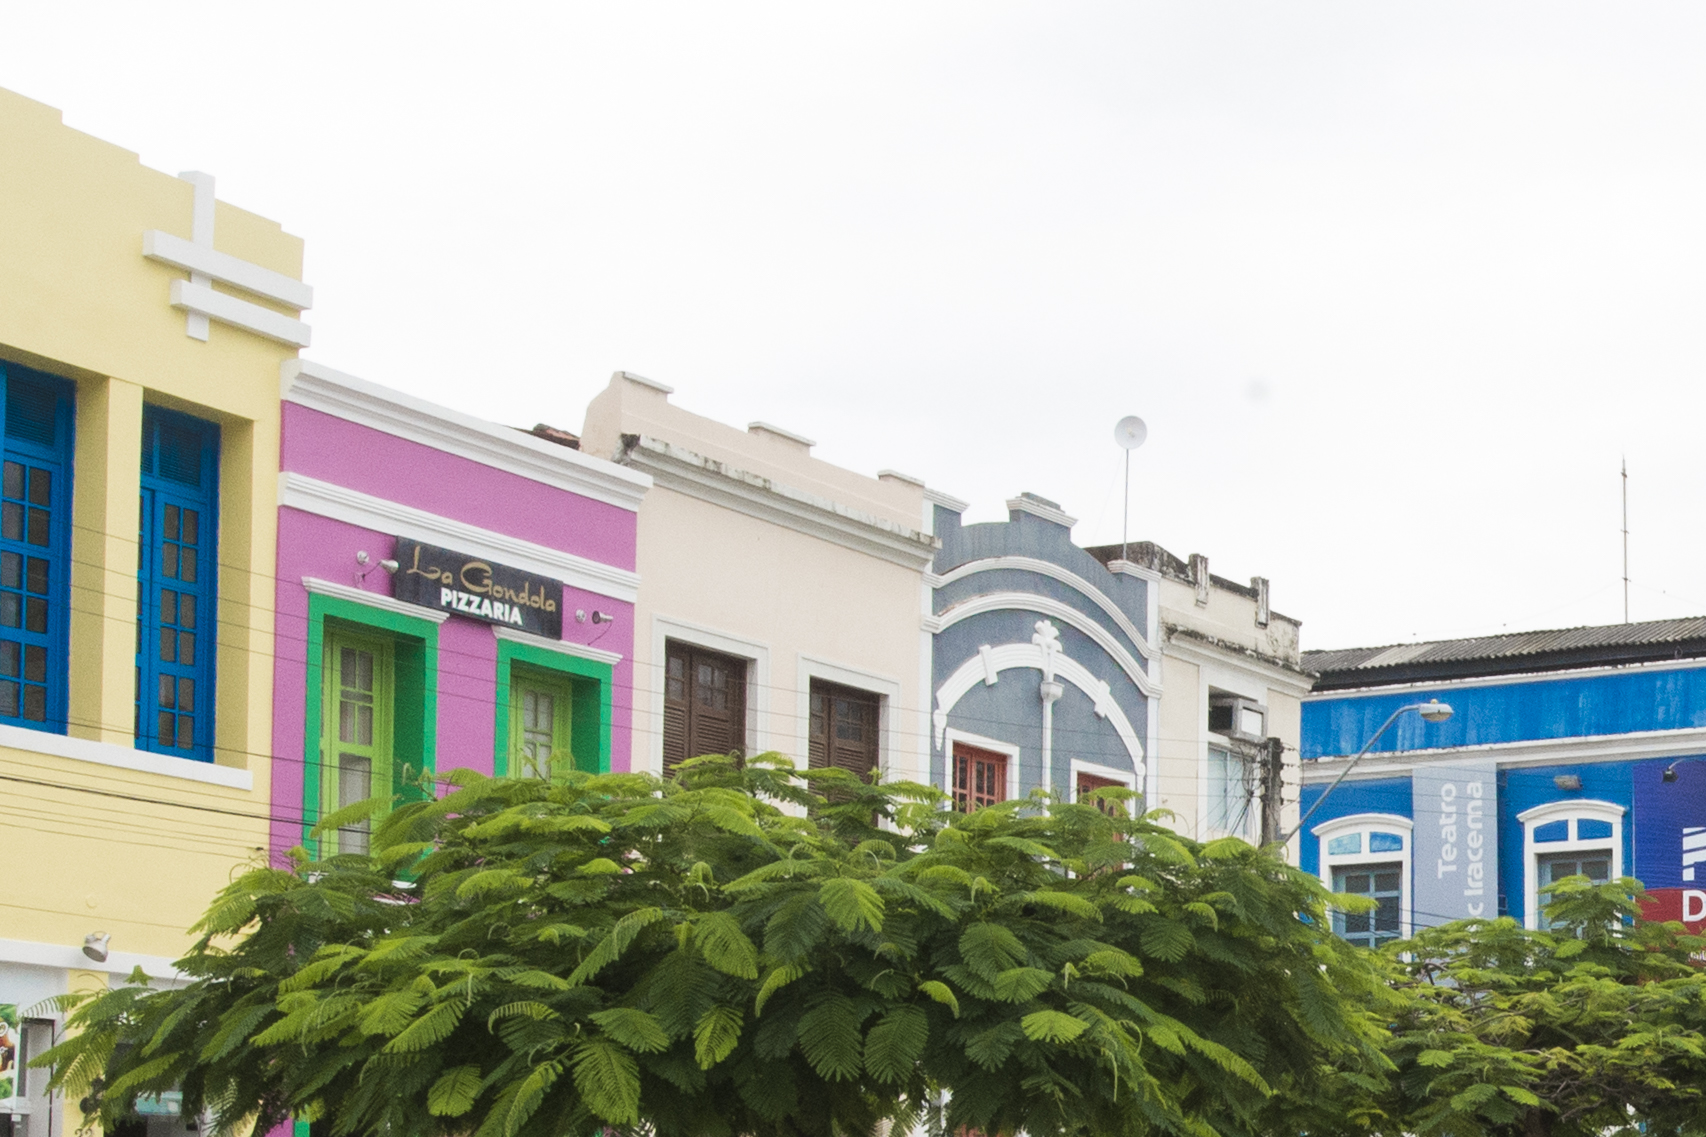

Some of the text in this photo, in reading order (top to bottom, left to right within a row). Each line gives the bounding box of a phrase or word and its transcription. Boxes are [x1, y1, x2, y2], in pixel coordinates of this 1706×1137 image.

[406, 546, 556, 612] La Gondola
[440, 587, 523, 626] PIZZARIA
[1437, 783, 1457, 879] Teatro
[1464, 781, 1484, 896] Iracema
